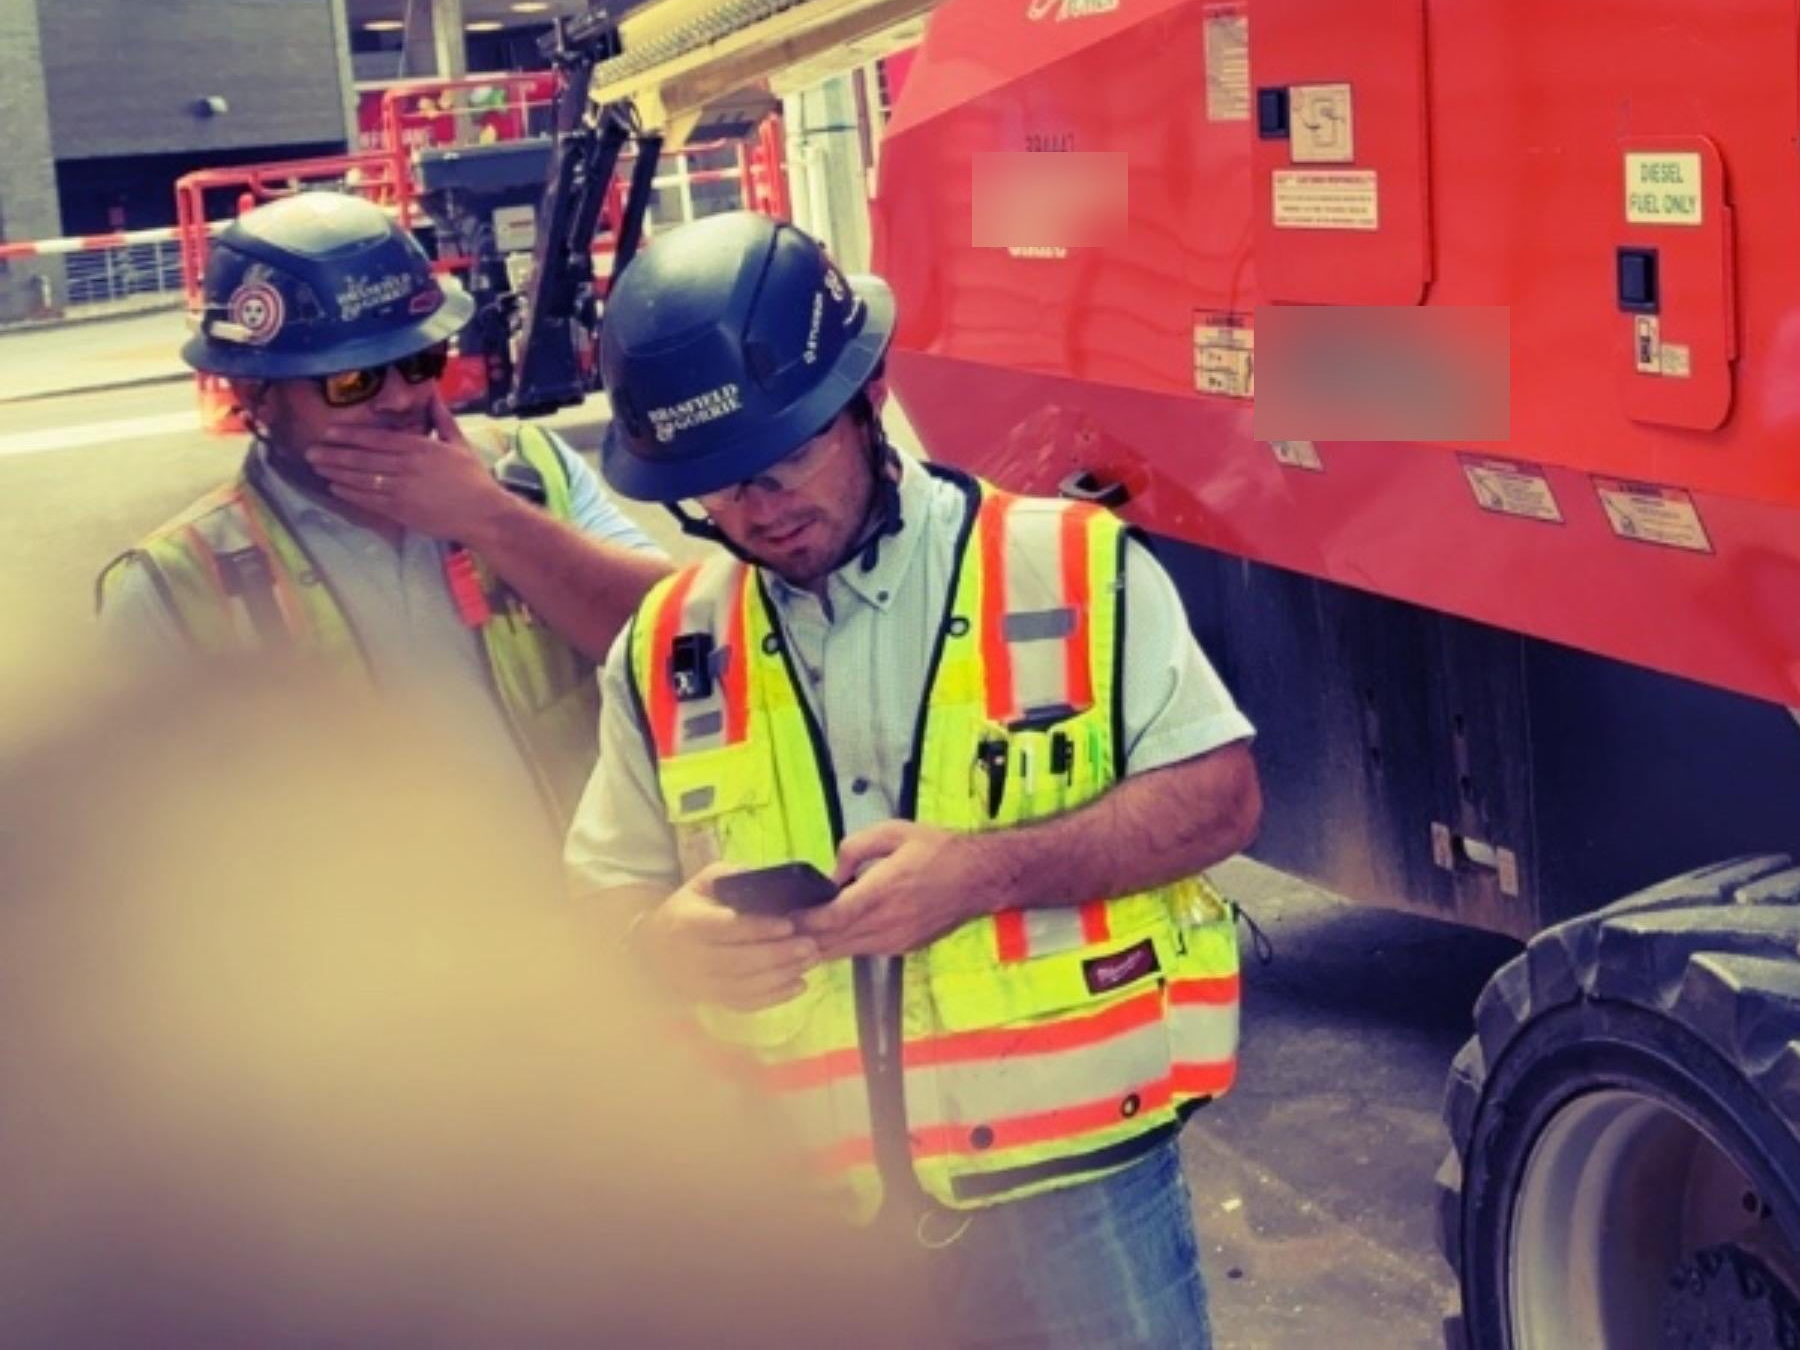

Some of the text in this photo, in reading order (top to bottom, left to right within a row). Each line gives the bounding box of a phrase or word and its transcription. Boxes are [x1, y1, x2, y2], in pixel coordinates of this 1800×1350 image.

[1640, 162, 1684, 184] DIESEL
[1630, 194, 1697, 215] FUEL ONLY
